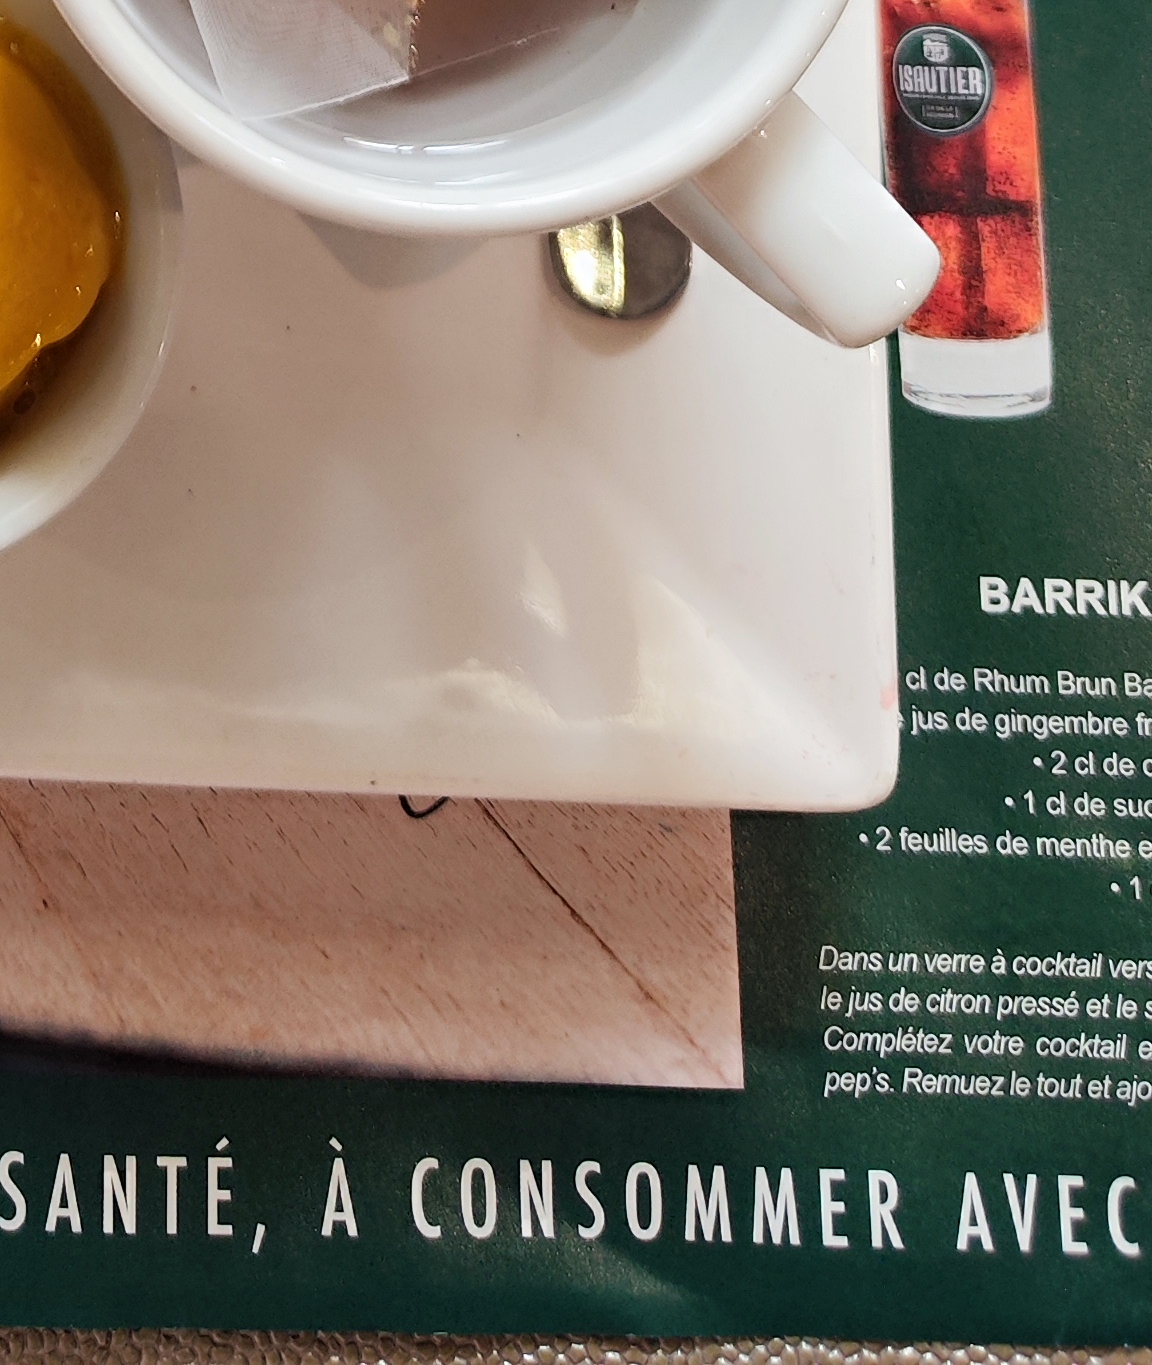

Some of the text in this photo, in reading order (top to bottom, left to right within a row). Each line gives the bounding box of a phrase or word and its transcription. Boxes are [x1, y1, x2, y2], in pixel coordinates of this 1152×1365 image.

[898, 64, 983, 95] ISAUTIER
[980, 576, 1152, 620] BARRIK
[906, 666, 927, 690] cl
[934, 667, 967, 693] de
[974, 668, 1050, 694] Rhum
[1058, 671, 1117, 697] Brun
[911, 705, 949, 735] jus
[956, 707, 988, 731] de
[995, 709, 1130, 740] gingembre
[1051, 751, 1067, 775] 2
[1075, 751, 1096, 776] cl
[1103, 752, 1136, 777] de
[1024, 790, 1035, 814] 1
[1046, 791, 1067, 815] cl
[1074, 792, 1107, 818] de
[876, 826, 892, 851] 2
[899, 827, 989, 855] feuilles
[996, 830, 1029, 855] de
[1037, 833, 1132, 860] menthe
[1130, 876, 1142, 899] 1
[819, 946, 883, 972] Dans
[889, 953, 920, 974] un
[924, 953, 985, 974] verre
[991, 949, 1006, 974] à
[1013, 952, 1102, 978] cocktail
[821, 986, 842, 1010] le
[845, 986, 883, 1017] jus
[889, 987, 921, 1013] de
[926, 988, 991, 1014] citron
[997, 991, 1079, 1020] pressé
[1086, 994, 1110, 1018] et
[1117, 994, 1138, 1019] le
[824, 1026, 953, 1058] Complétez
[964, 1030, 1024, 1056] votre
[1036, 1033, 1127, 1059] cocktail
[903, 1068, 1004, 1096] Remuez
[1010, 1071, 1031, 1097] le
[1037, 1073, 1083, 1098] tout
[1088, 1075, 1112, 1099] et
[0, 1137, 265, 1253] SANTÉ,
[322, 1137, 358, 1237] À
[412, 1158, 904, 1249] CONSOMMER
[957, 1172, 1140, 1258] AVEC
